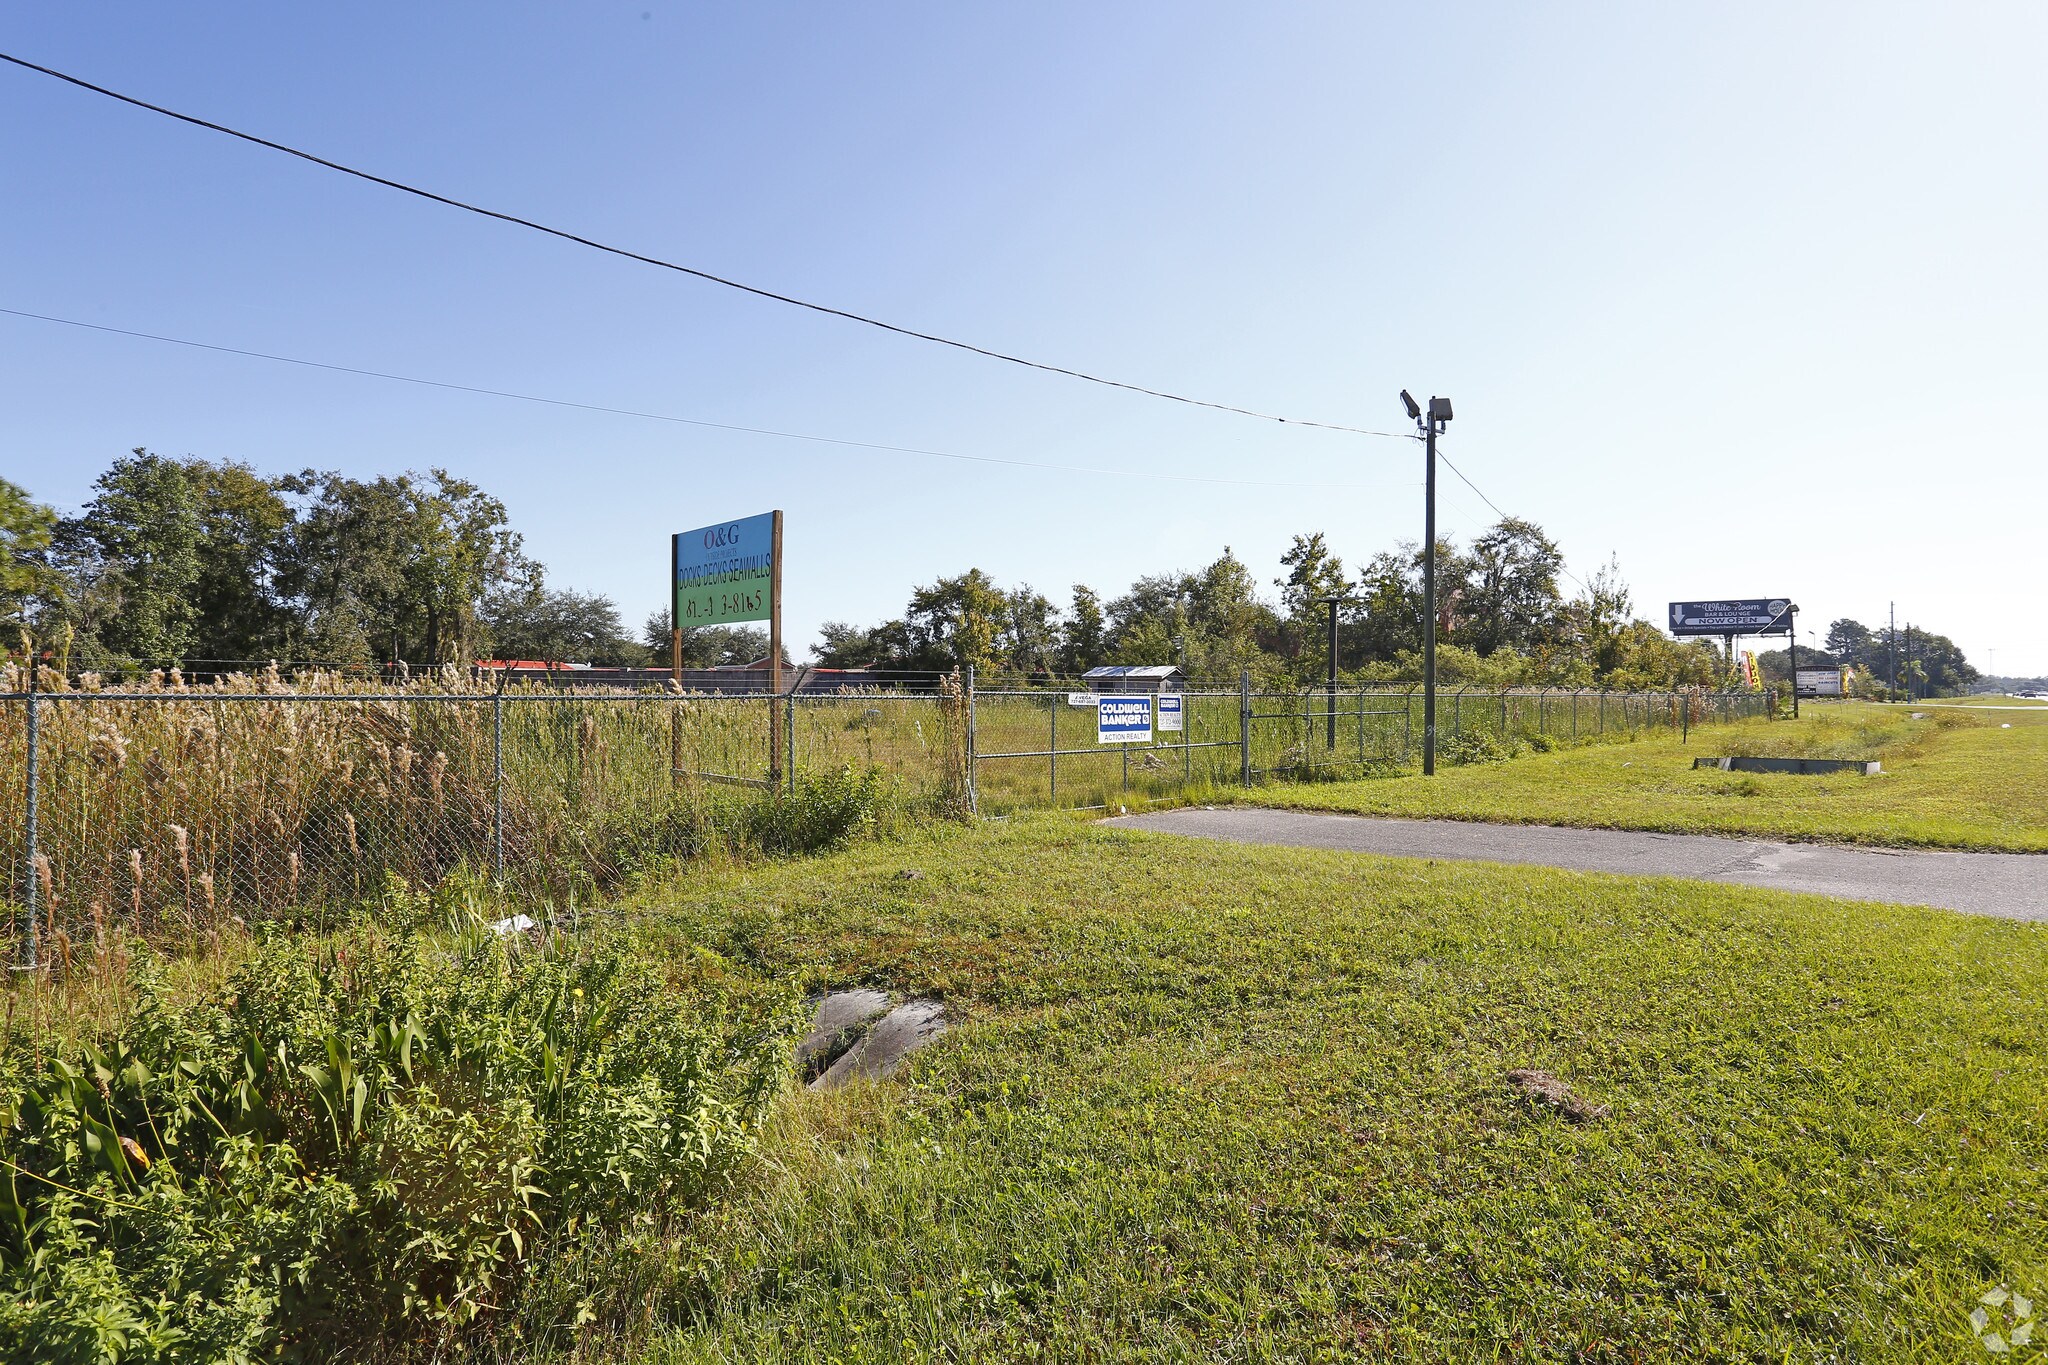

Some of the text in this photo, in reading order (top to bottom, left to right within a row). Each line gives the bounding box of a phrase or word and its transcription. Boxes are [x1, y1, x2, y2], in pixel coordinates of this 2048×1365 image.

[704, 525, 739, 549] O&G
[1100, 703, 1149, 714] COLDWELL
[1101, 714, 1141, 726] BANKER
[1104, 732, 1147, 741] ACTION REALTY
